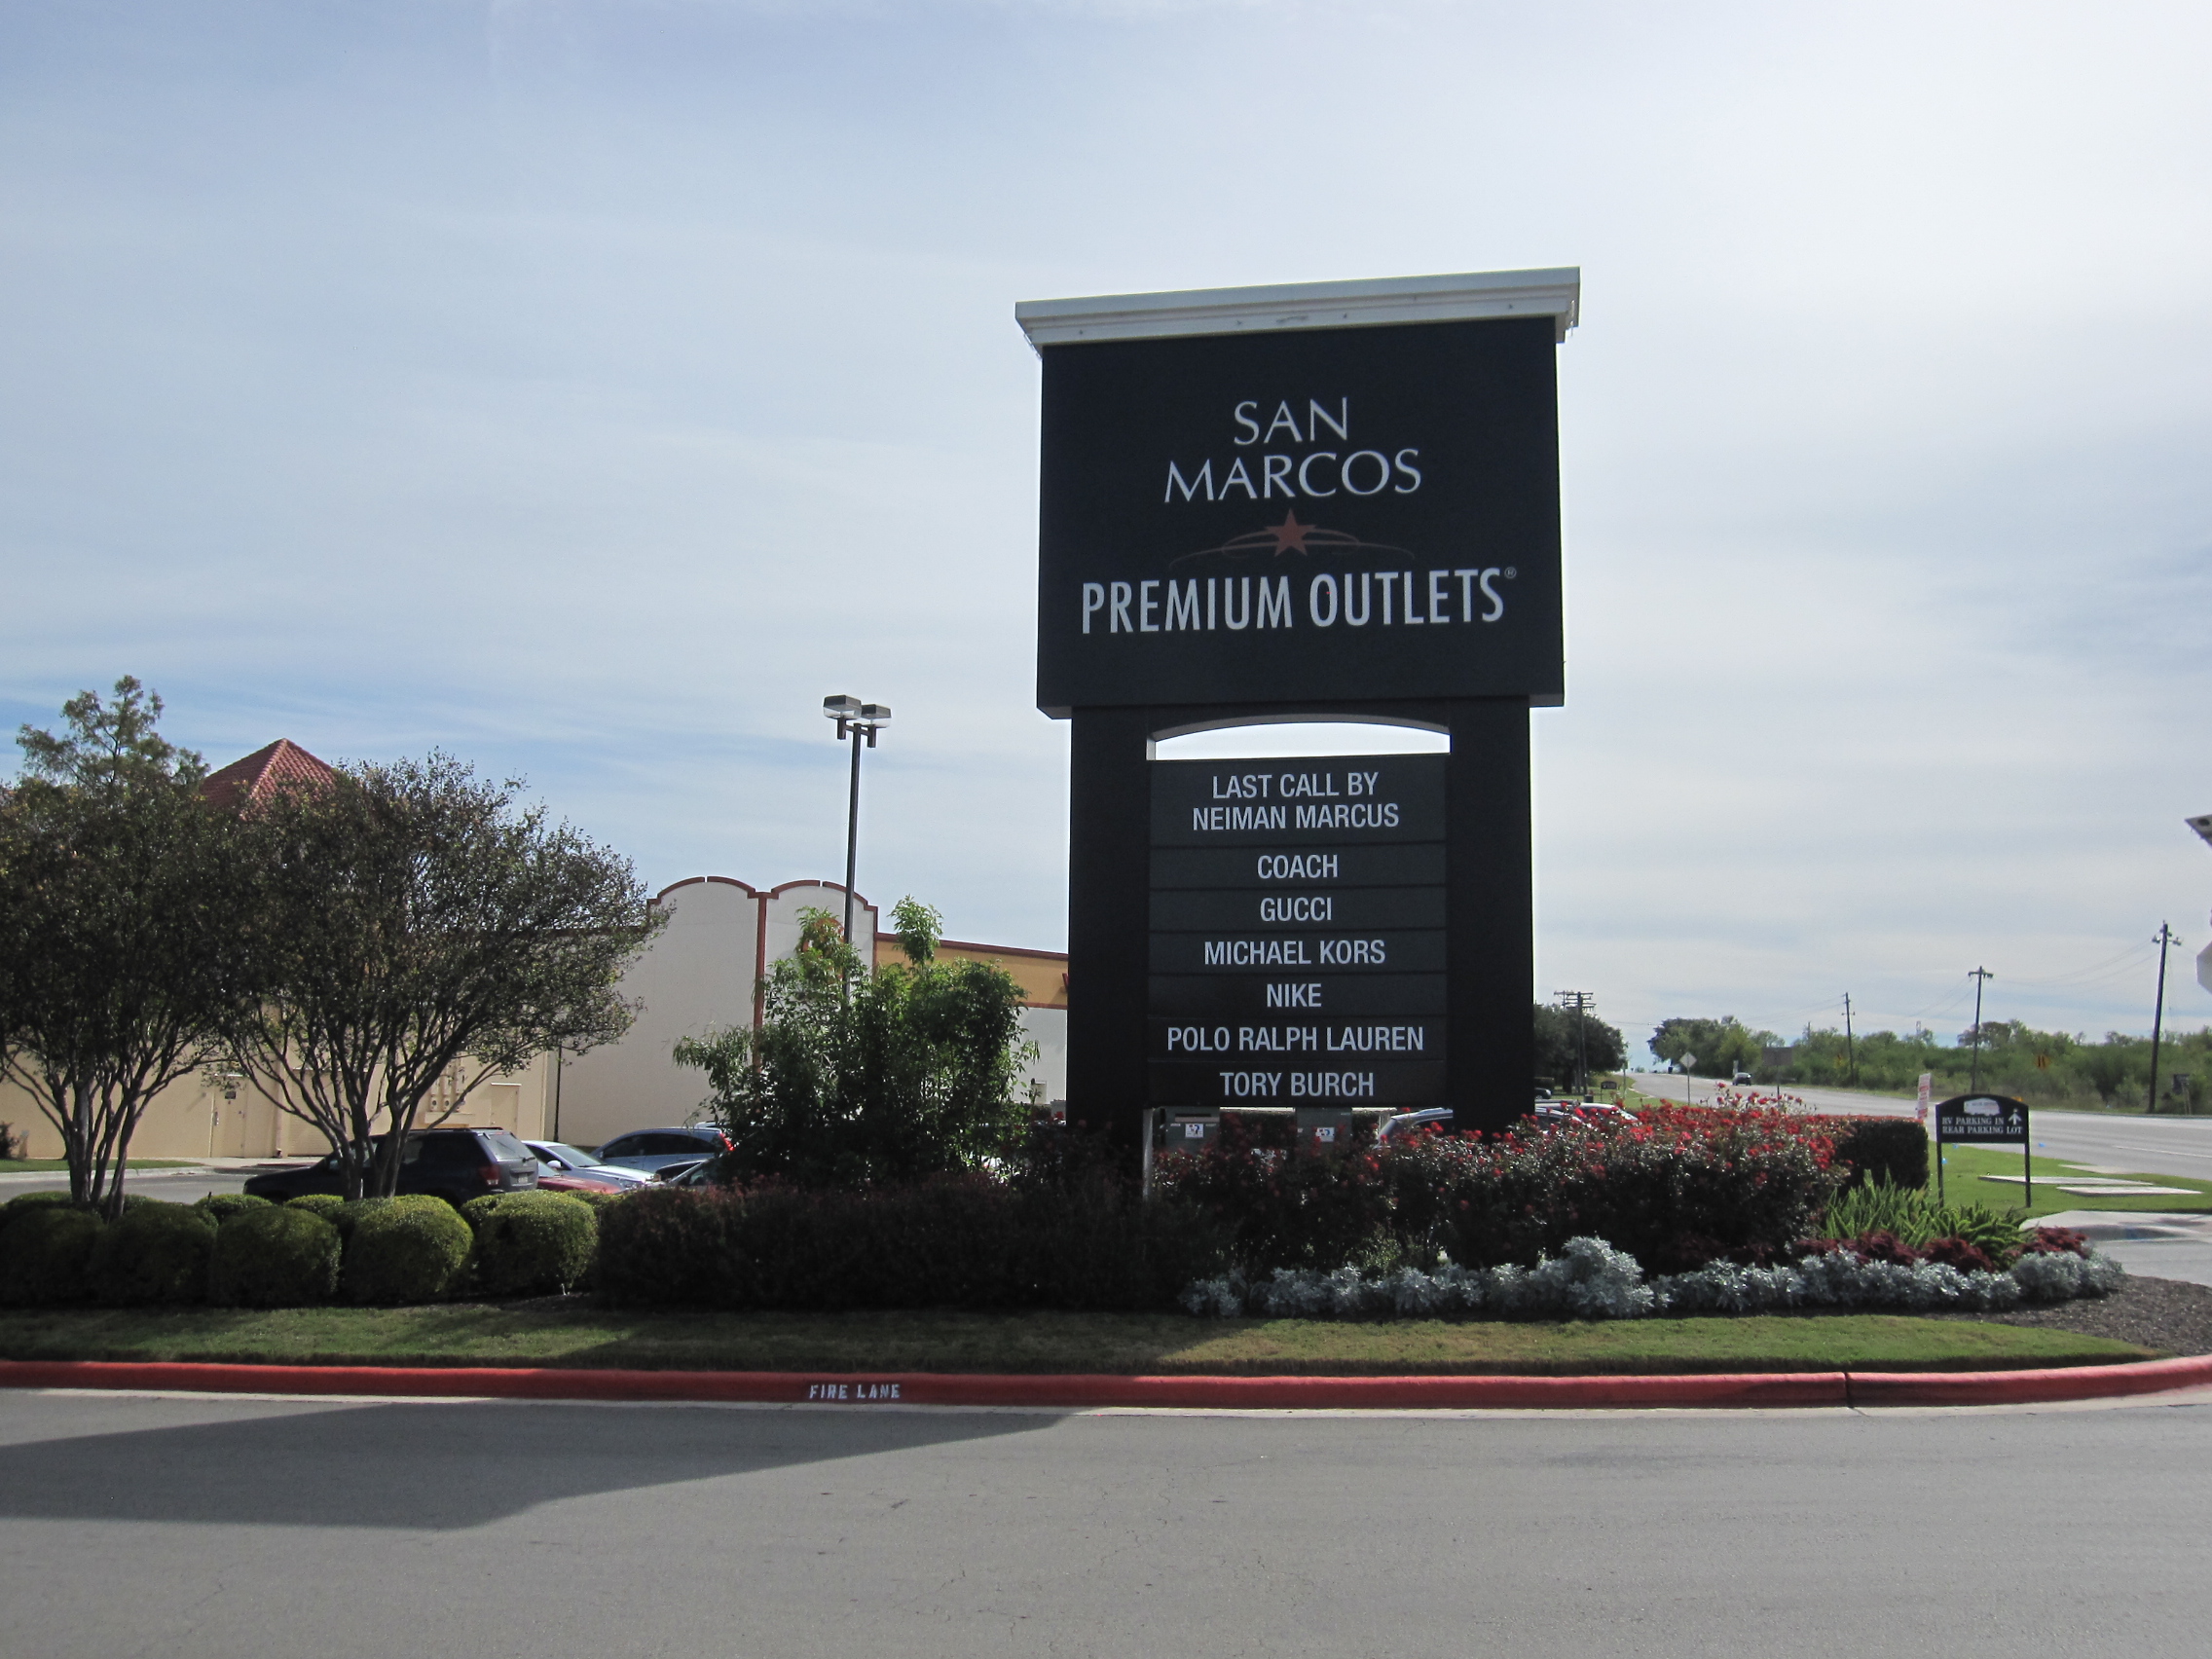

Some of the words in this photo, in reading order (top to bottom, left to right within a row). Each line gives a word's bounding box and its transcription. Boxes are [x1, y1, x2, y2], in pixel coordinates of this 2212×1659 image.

[1234, 396, 1348, 446] SAN
[1163, 448, 1421, 503] MARCOS
[1082, 575, 1293, 634] PREMIUM
[1212, 774, 1272, 799] LAST
[1279, 773, 1340, 797] CALL
[1347, 771, 1380, 796] BY
[1193, 805, 1286, 830] NEIMAN
[1296, 802, 1399, 829] MARCUS
[1257, 854, 1338, 879] COACH
[1260, 897, 1332, 922] GUCCI
[1204, 940, 1311, 965] MICHAEL
[1319, 939, 1385, 965] KORS
[1267, 982, 1322, 1008] NIKE
[1167, 1026, 1231, 1051] POLO
[1238, 1026, 1317, 1051] RALPH
[1326, 1026, 1423, 1051] LAUREN
[1219, 1071, 1282, 1096] TORY
[1290, 1071, 1374, 1097] BURCH
[1941, 1117, 1953, 1125] RV
[1955, 1117, 1993, 1125] PARKING
[1994, 1117, 2005, 1125] IN
[1941, 1125, 1965, 1134] REAR
[1967, 1125, 2004, 1134] PARKING
[2006, 1125, 2023, 1134] LOT
[809, 1383, 849, 1400] FIRE
[856, 1383, 901, 1399] LANE
